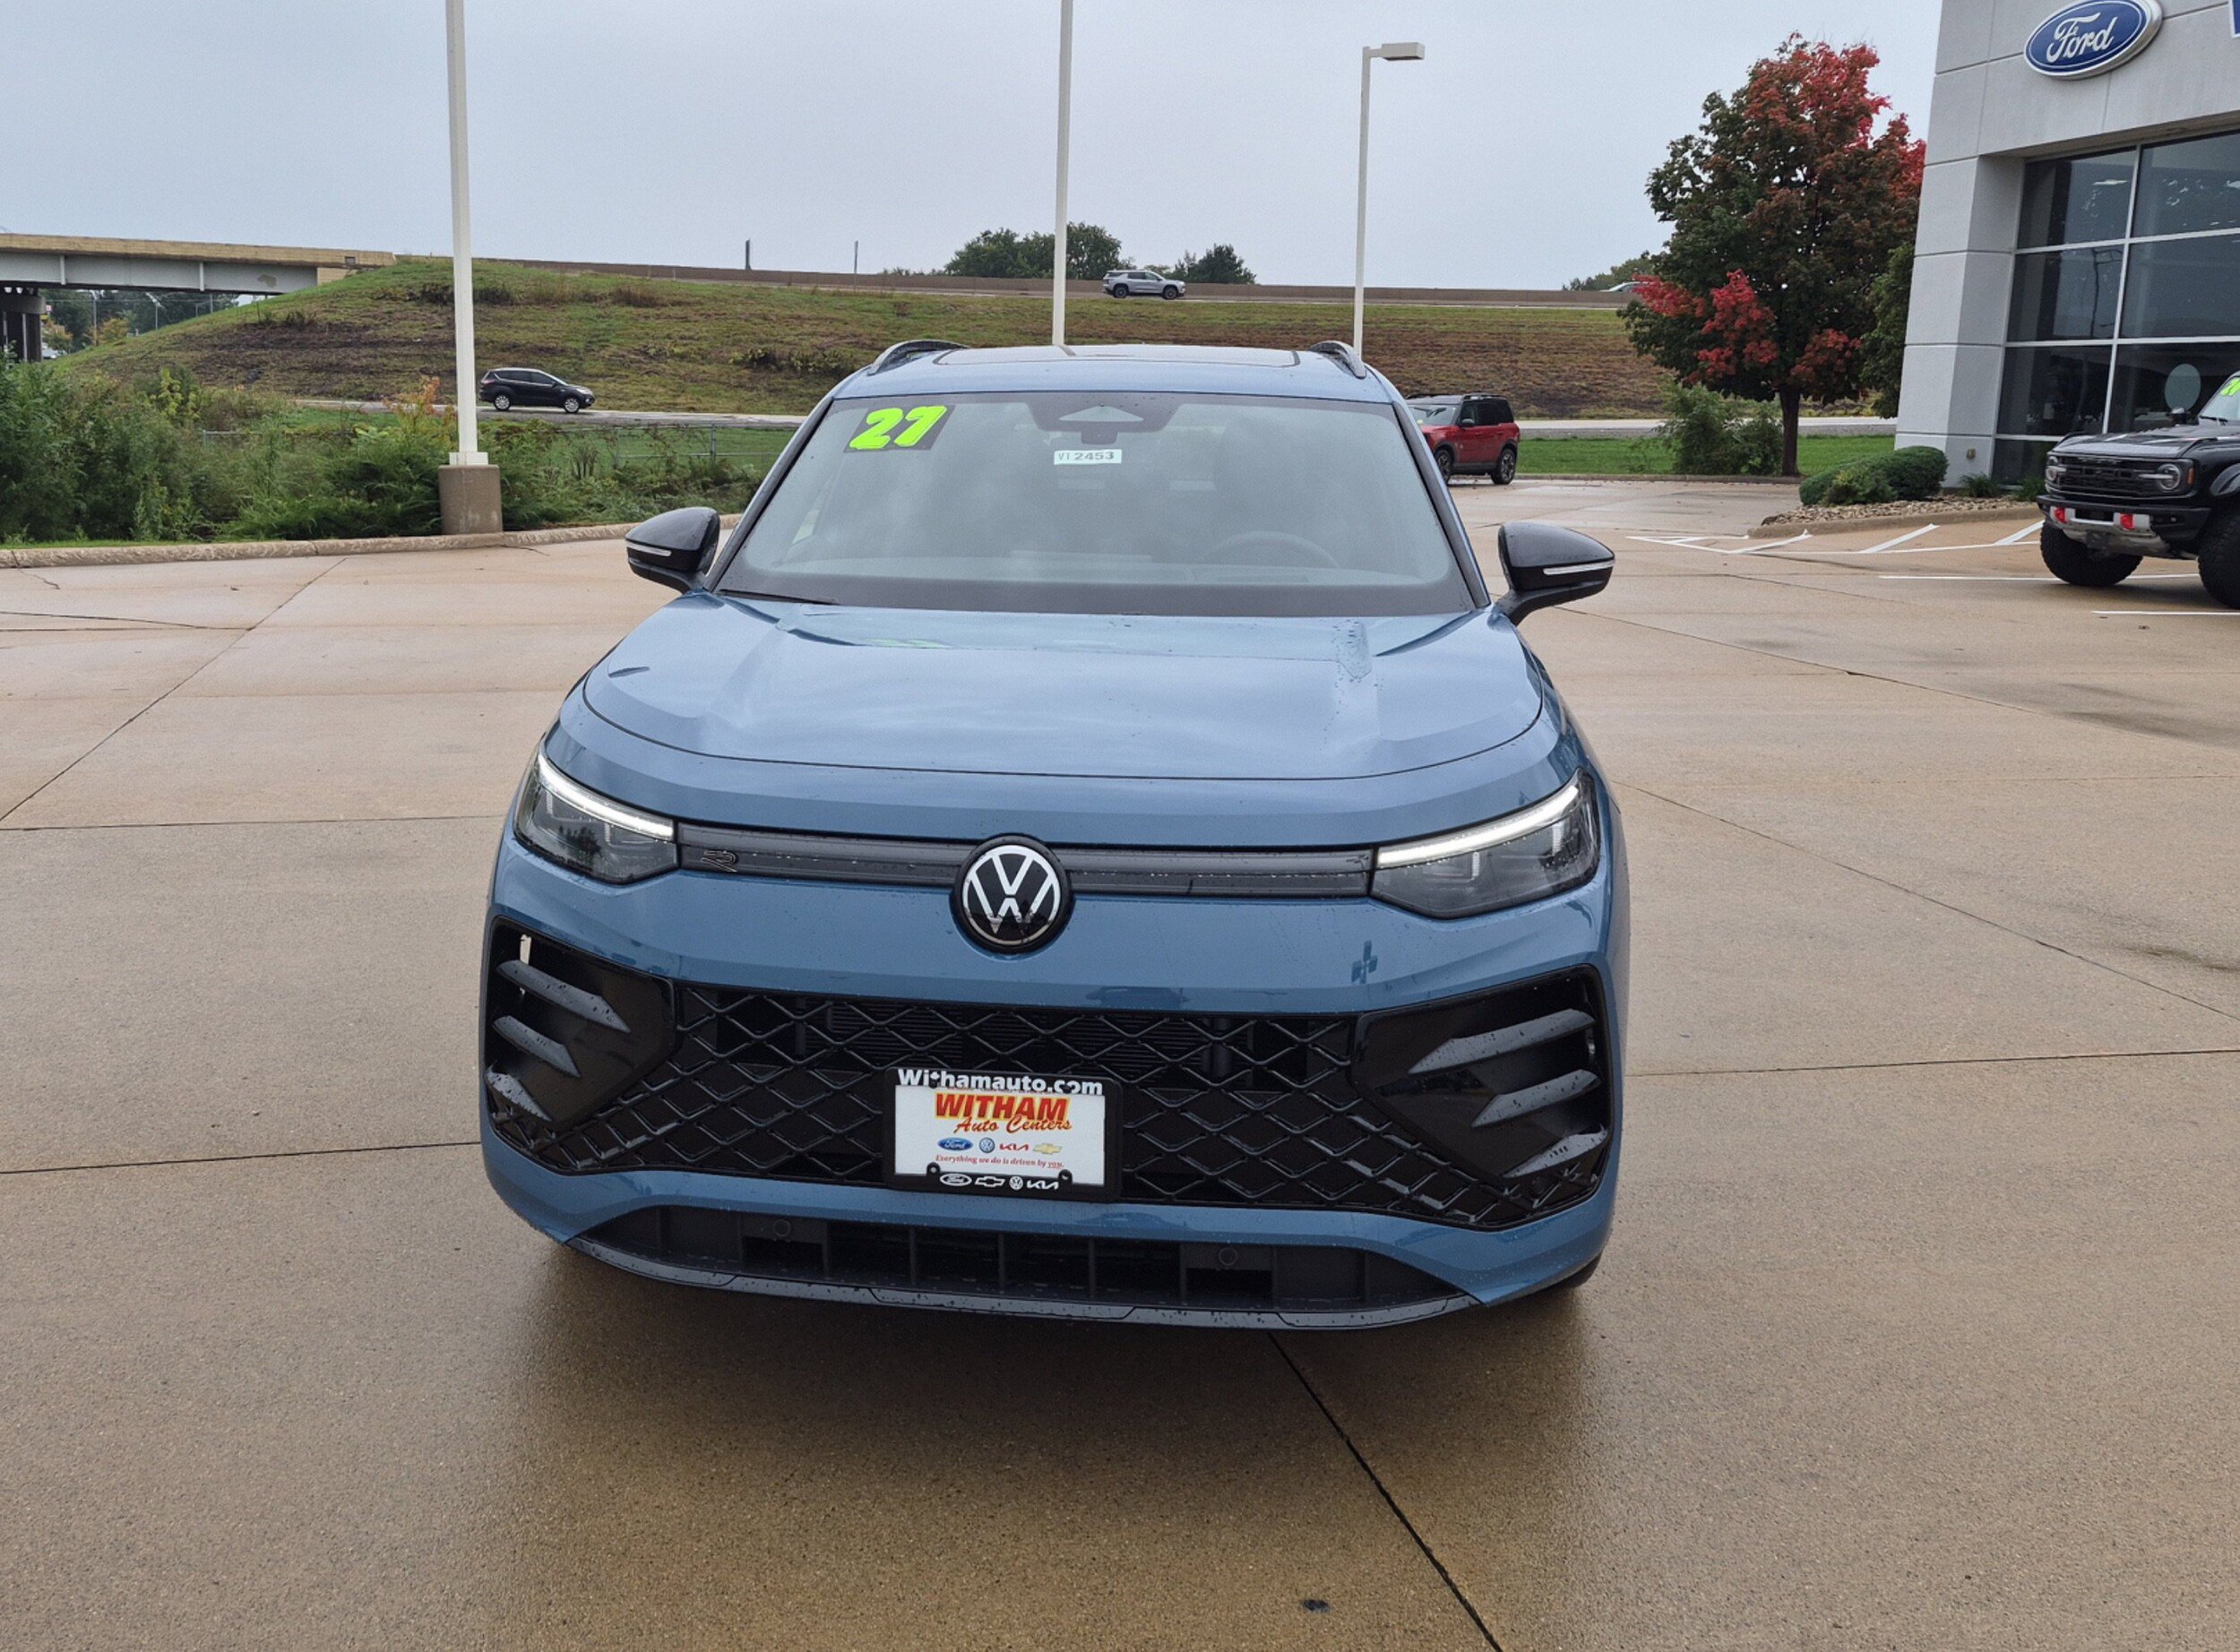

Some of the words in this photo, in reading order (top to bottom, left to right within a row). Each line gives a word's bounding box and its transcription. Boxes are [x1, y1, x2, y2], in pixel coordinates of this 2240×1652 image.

[2046, 13, 2118, 64] Ford
[849, 405, 948, 450] 27
[935, 1092, 1069, 1122] WITHAM
[952, 1115, 1000, 1134] Auto
[1005, 1114, 1073, 1134] Centers
[935, 1154, 978, 1165] Everything
